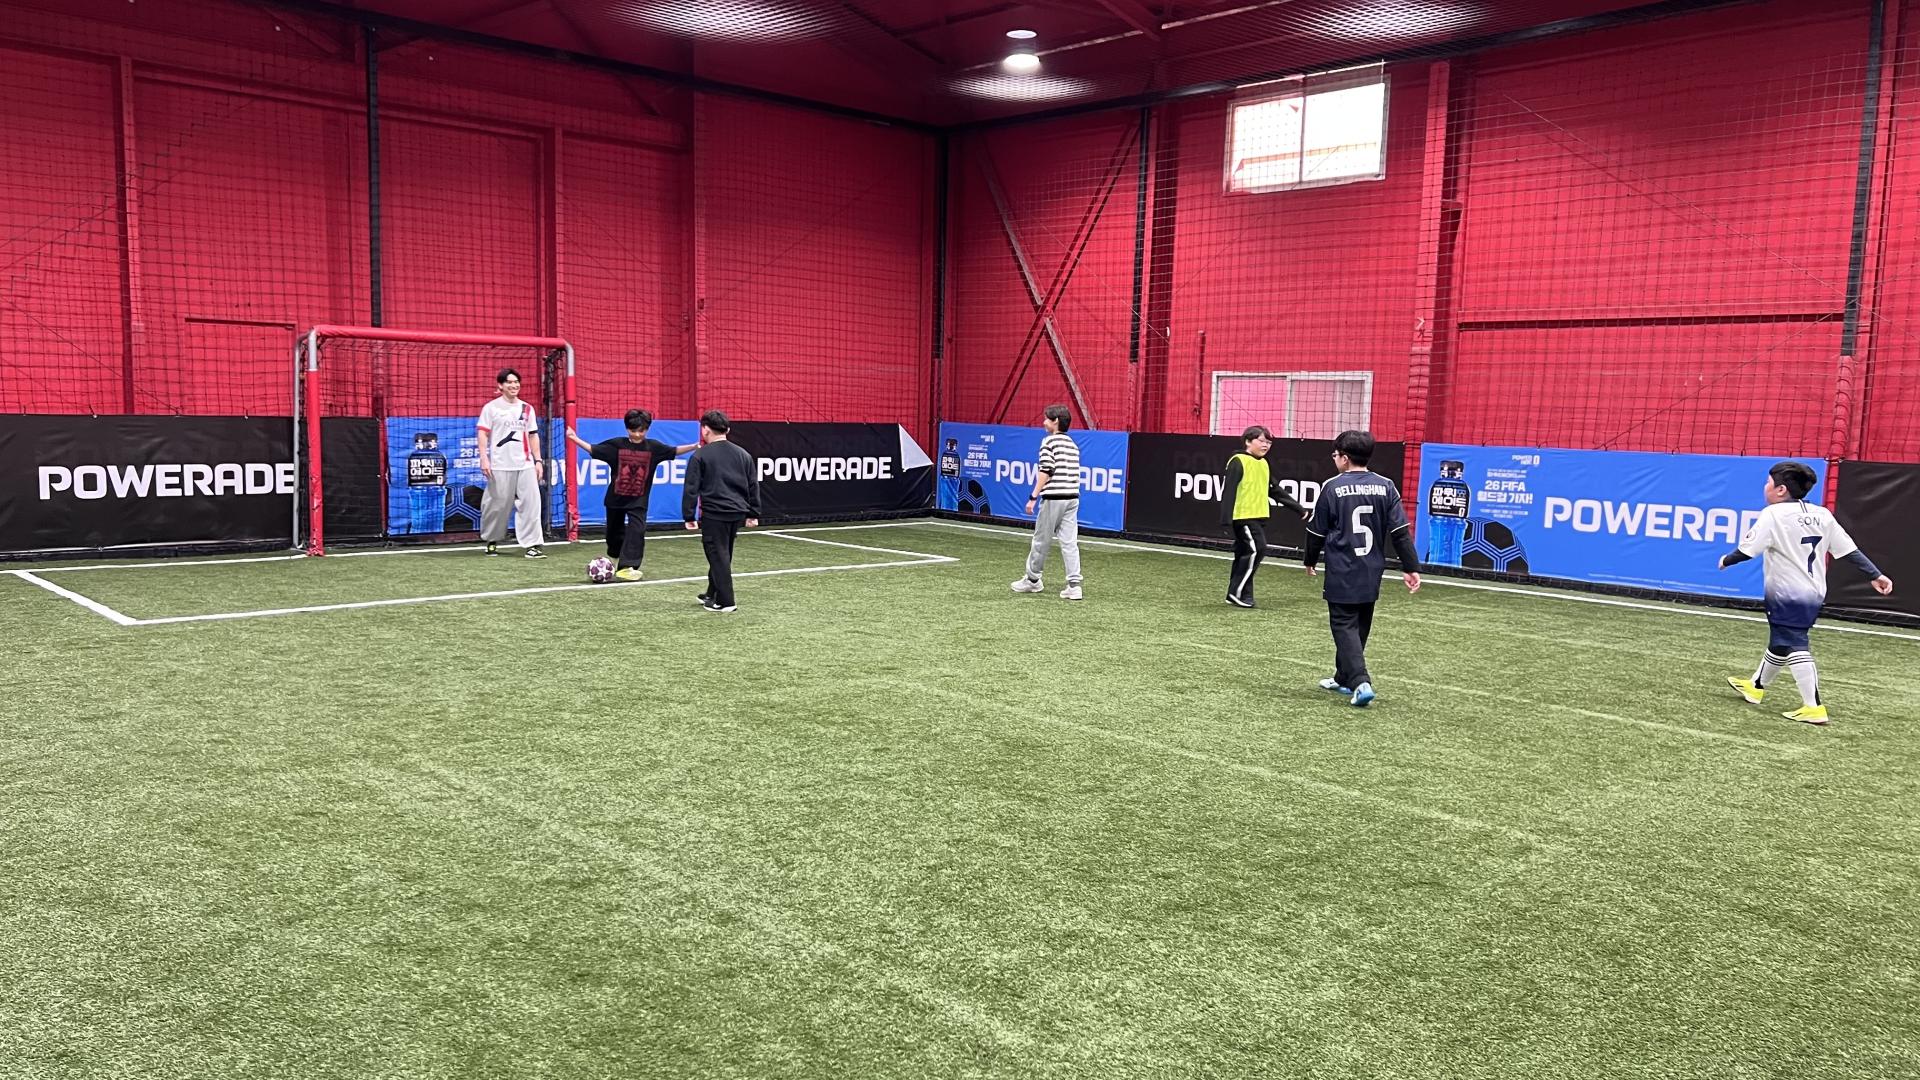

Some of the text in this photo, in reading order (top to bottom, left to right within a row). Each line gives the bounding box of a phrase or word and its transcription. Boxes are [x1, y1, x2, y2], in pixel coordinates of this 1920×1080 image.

[460, 447, 473, 457] 26
[757, 456, 892, 482] POWERADE
[38, 463, 294, 500] POWERADE
[1484, 479, 1526, 492] 26 FIFA
[1334, 483, 1387, 498] BELLINGHAM
[1431, 496, 1467, 507] 에이드
[1797, 516, 1820, 527] SON
[1351, 504, 1374, 557] 5
[1800, 535, 1823, 578] 7
